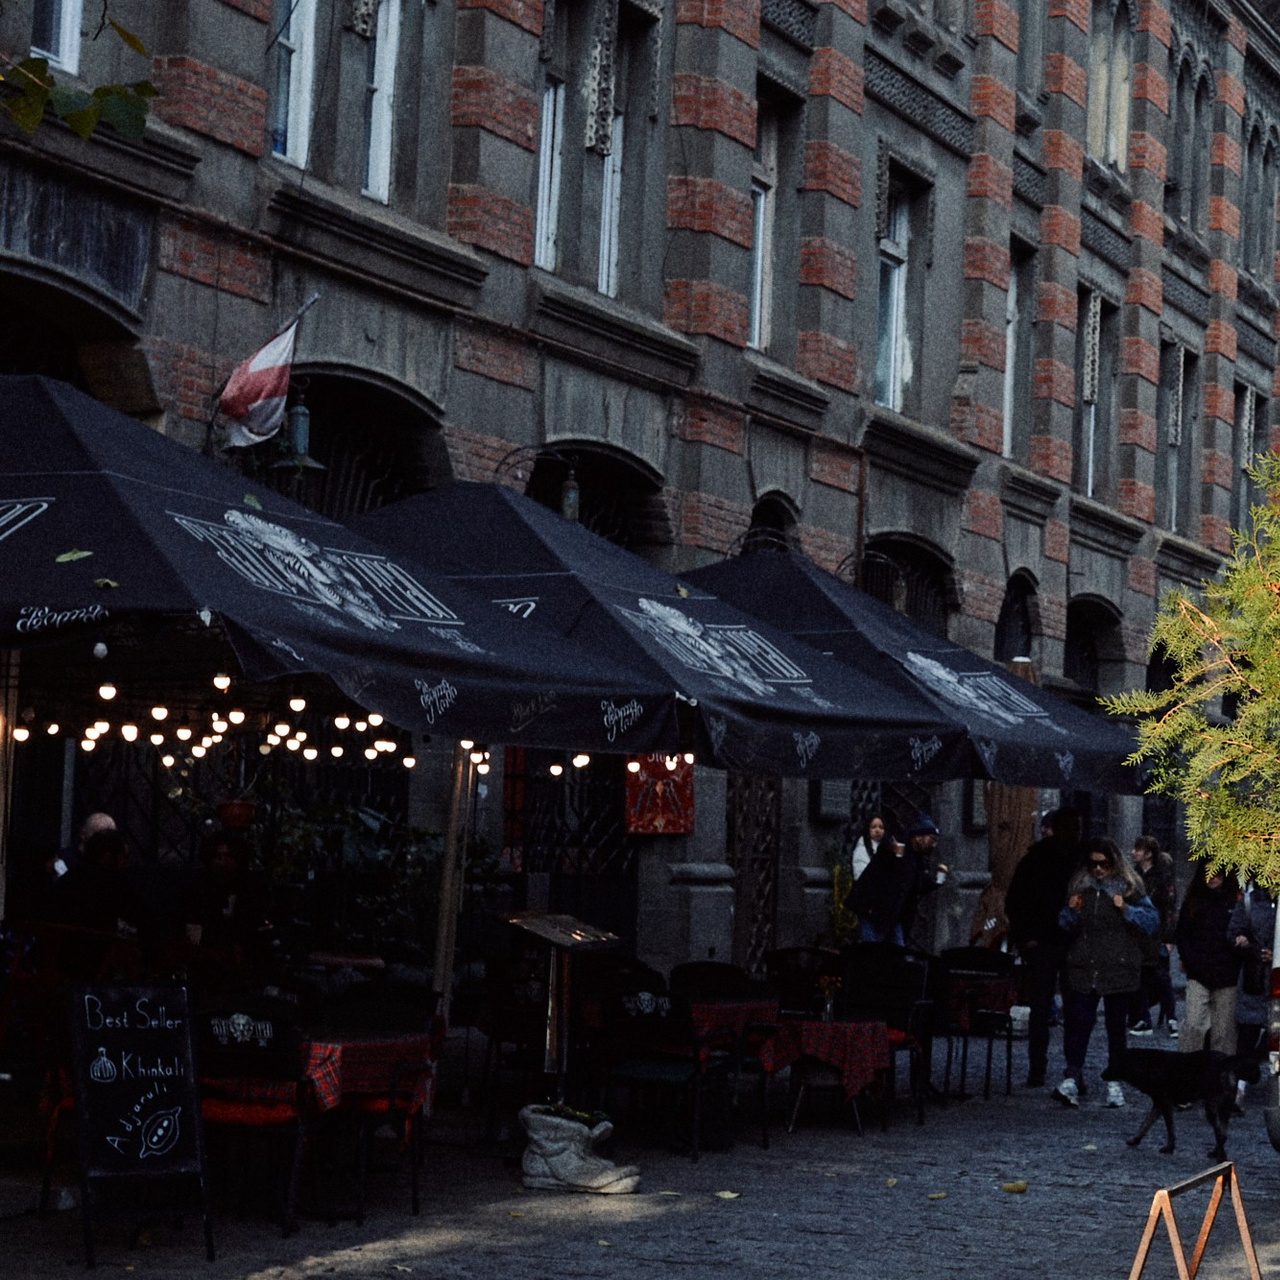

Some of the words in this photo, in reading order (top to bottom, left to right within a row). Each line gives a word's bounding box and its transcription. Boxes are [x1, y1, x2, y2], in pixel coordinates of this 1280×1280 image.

[84, 994, 129, 1030] Best
[135, 998, 183, 1029] Seller
[121, 1050, 184, 1079] Khinkali
[106, 1081, 167, 1154] Adjaruli
